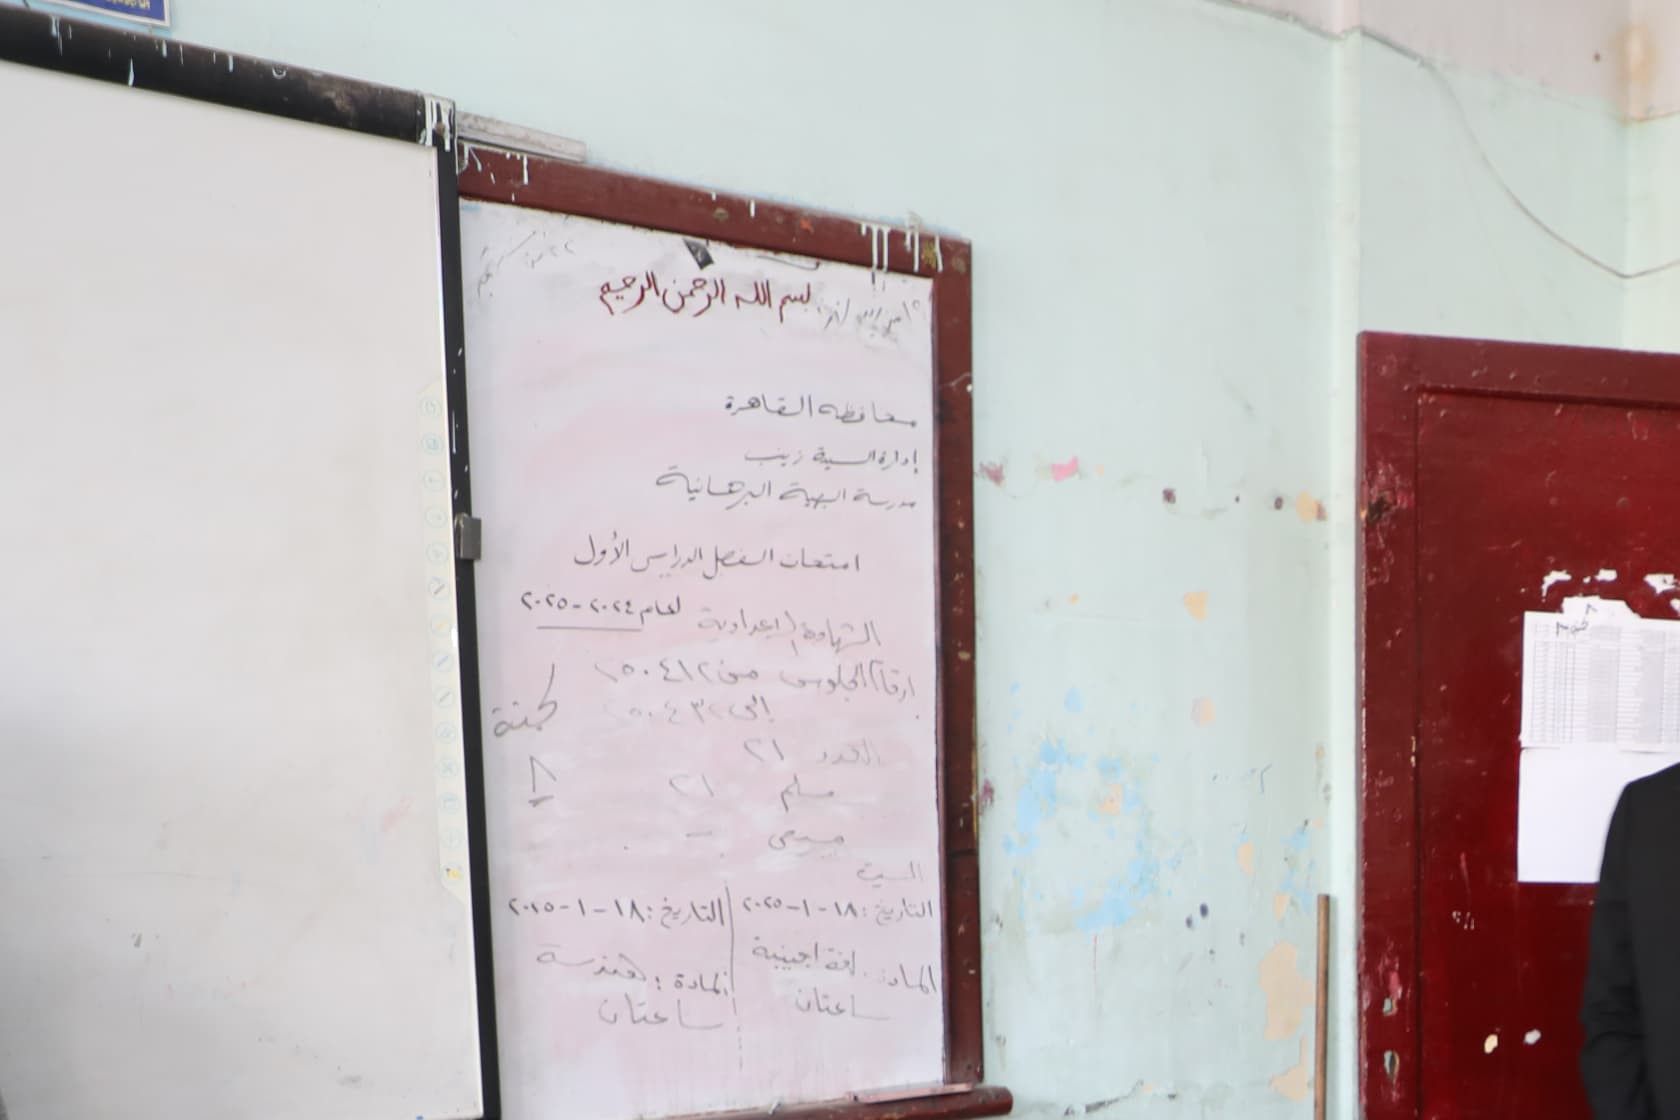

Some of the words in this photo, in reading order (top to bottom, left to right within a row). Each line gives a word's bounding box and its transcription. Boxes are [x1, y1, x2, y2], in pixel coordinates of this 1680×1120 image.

[599, 270, 660, 316] الرحيم
[661, 276, 726, 318] الرحمن
[735, 279, 773, 310] الله
